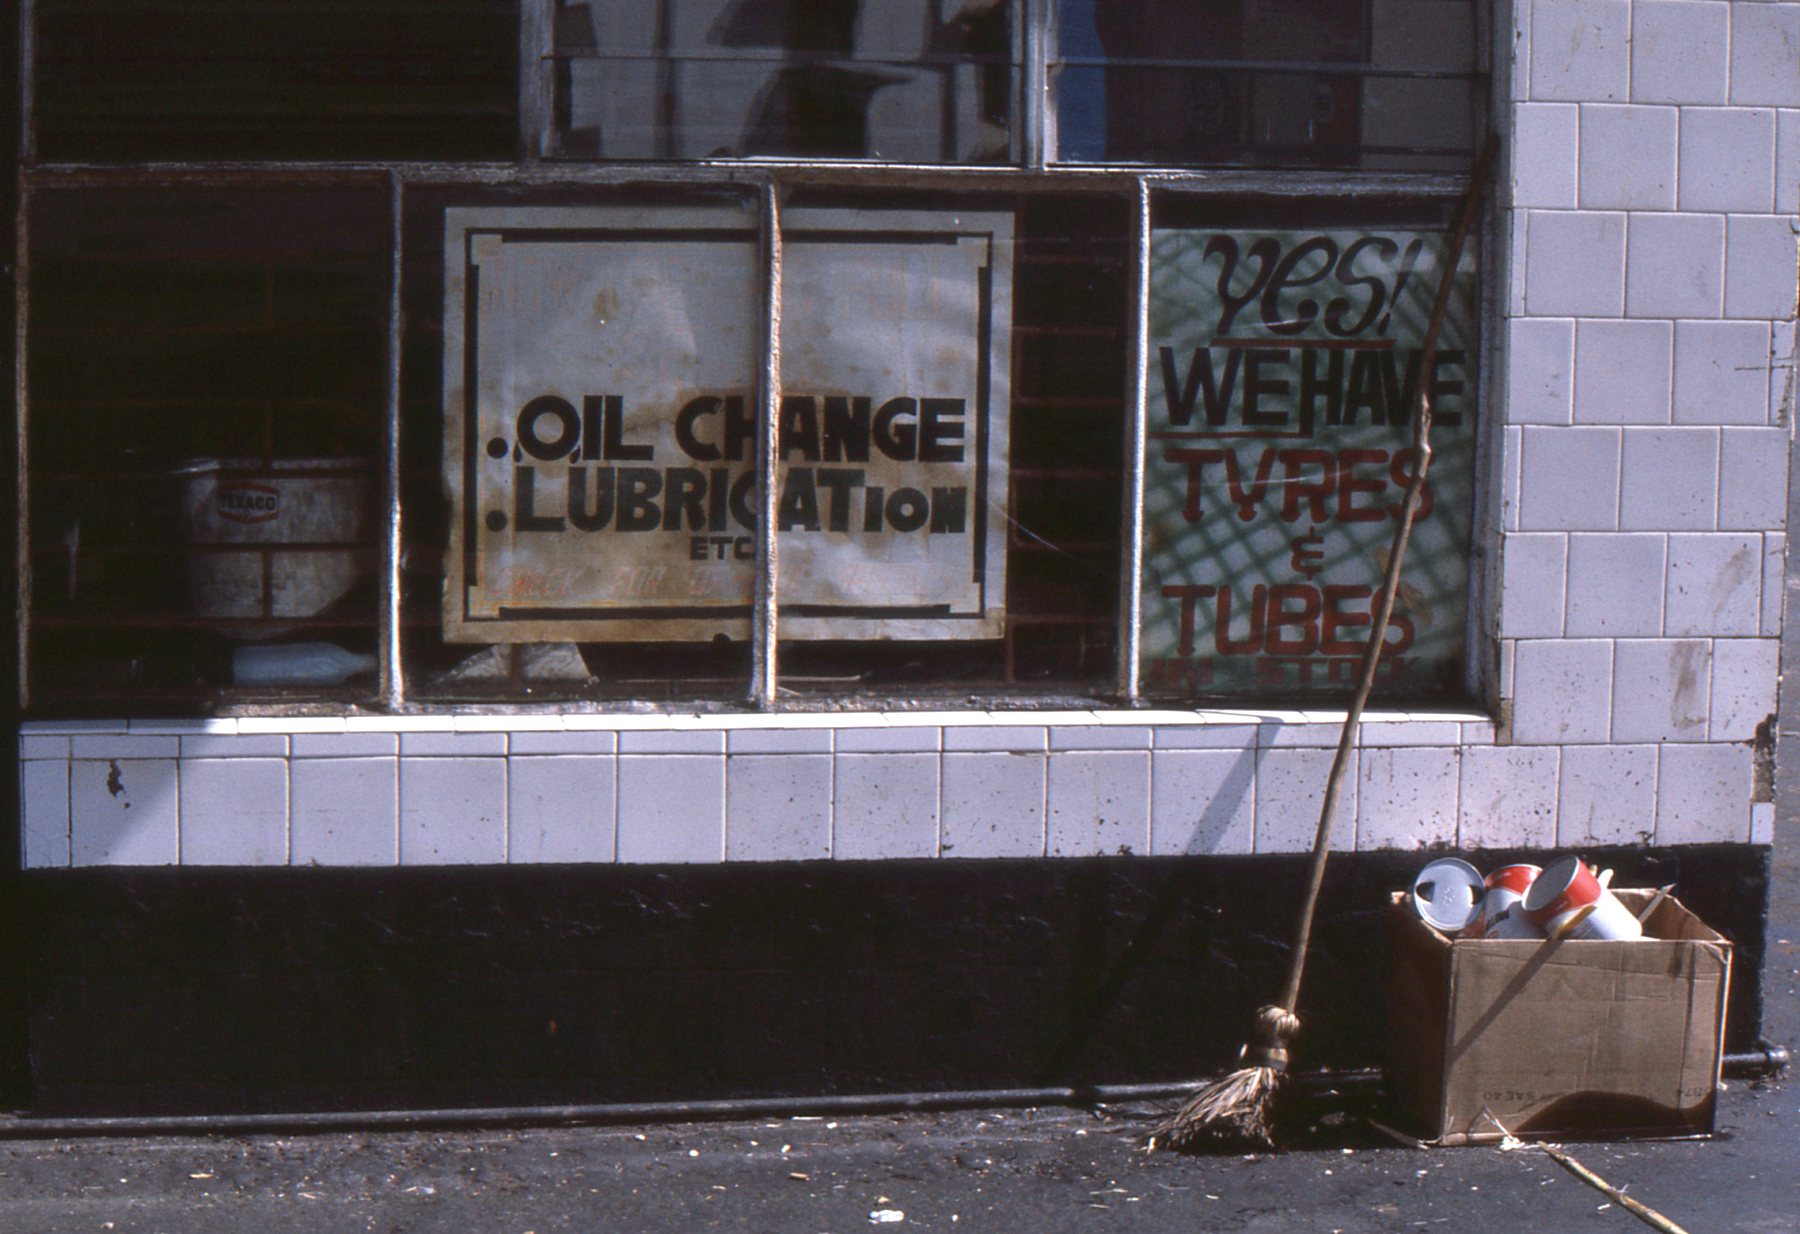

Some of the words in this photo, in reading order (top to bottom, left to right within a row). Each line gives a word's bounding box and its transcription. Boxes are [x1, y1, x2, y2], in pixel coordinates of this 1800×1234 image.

[1159, 346, 1289, 427] WE
[1301, 347, 1465, 429] HAVE
[514, 395, 654, 463] OIL
[675, 395, 966, 462] CHANGE
[514, 466, 967, 534] LUBRICATION
[1163, 447, 1434, 523] TYRES
[1291, 527, 1324, 580] &
[1161, 584, 1415, 656] TUBES
